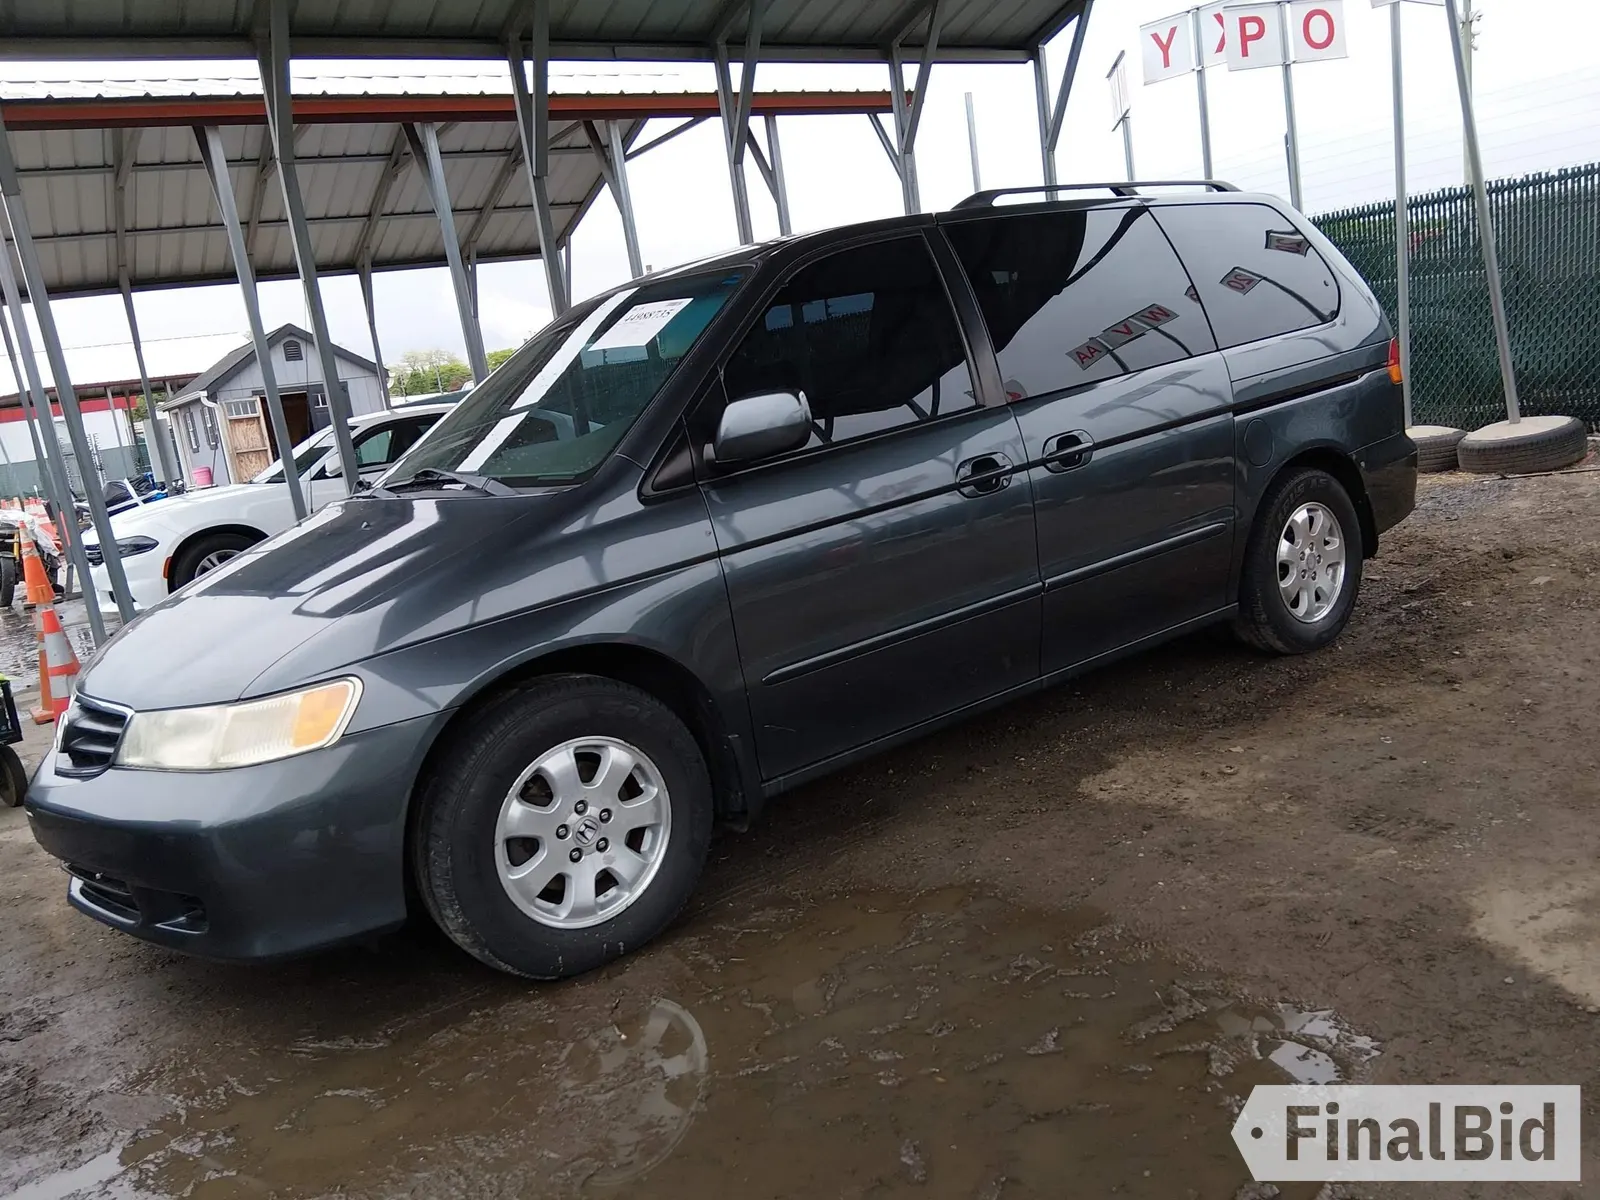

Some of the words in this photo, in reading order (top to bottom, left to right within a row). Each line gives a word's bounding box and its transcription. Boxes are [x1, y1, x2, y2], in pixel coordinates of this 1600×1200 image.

[1150, 25, 1178, 69] Y
[1238, 15, 1266, 58] P
[1302, 8, 1335, 50] O
